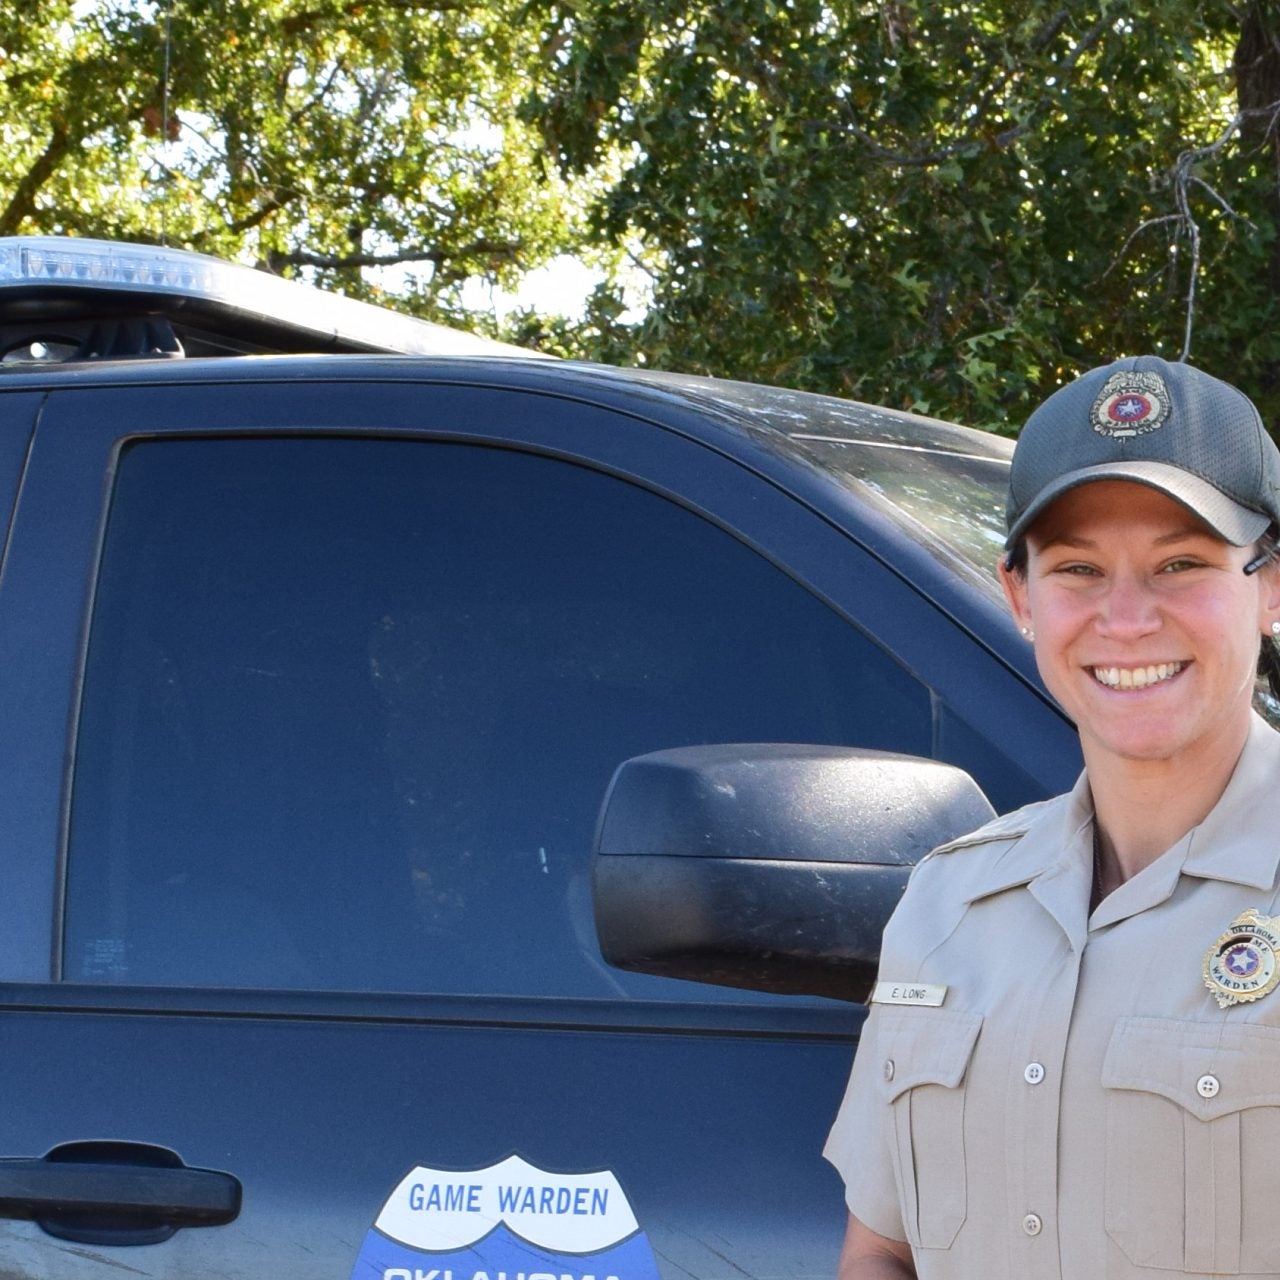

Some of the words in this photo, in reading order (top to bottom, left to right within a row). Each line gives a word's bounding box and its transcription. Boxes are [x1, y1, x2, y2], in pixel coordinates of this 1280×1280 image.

[1212, 965, 1259, 990] WARDEN
[902, 988, 927, 1000] LONG
[408, 1183, 483, 1212] GAME
[498, 1185, 608, 1216] WARDEN
